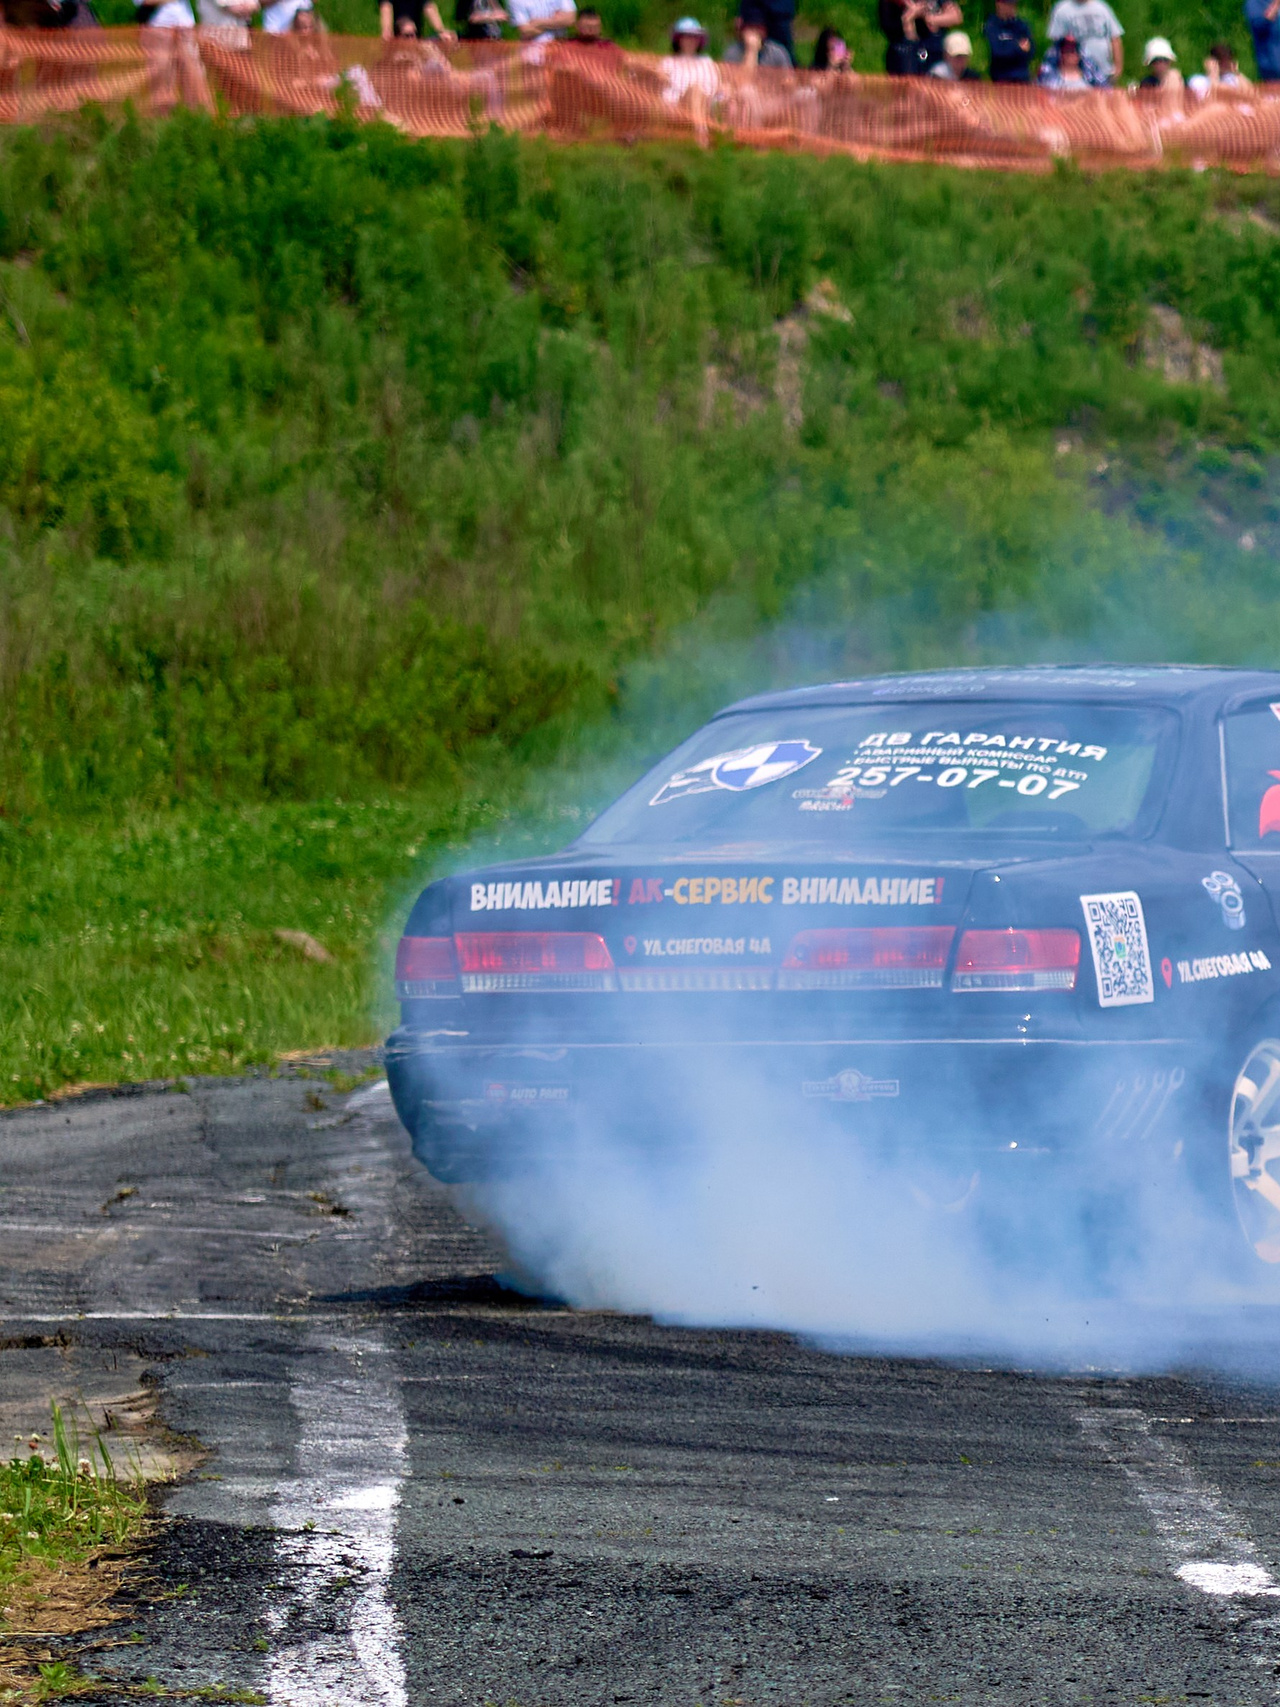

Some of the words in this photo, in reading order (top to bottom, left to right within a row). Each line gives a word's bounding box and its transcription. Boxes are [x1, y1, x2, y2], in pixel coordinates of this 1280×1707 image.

[858, 731, 912, 748] ДВ
[920, 731, 1108, 761] ГАРАНТИЯ
[968, 749, 1058, 763] КОМИССАР
[826, 766, 1081, 800] 257-07-07
[470, 879, 619, 911] ВНИМАНИЕ!
[628, 877, 774, 905] АК-СЕРВИС
[782, 877, 945, 906] ВНИМАНИЕ!
